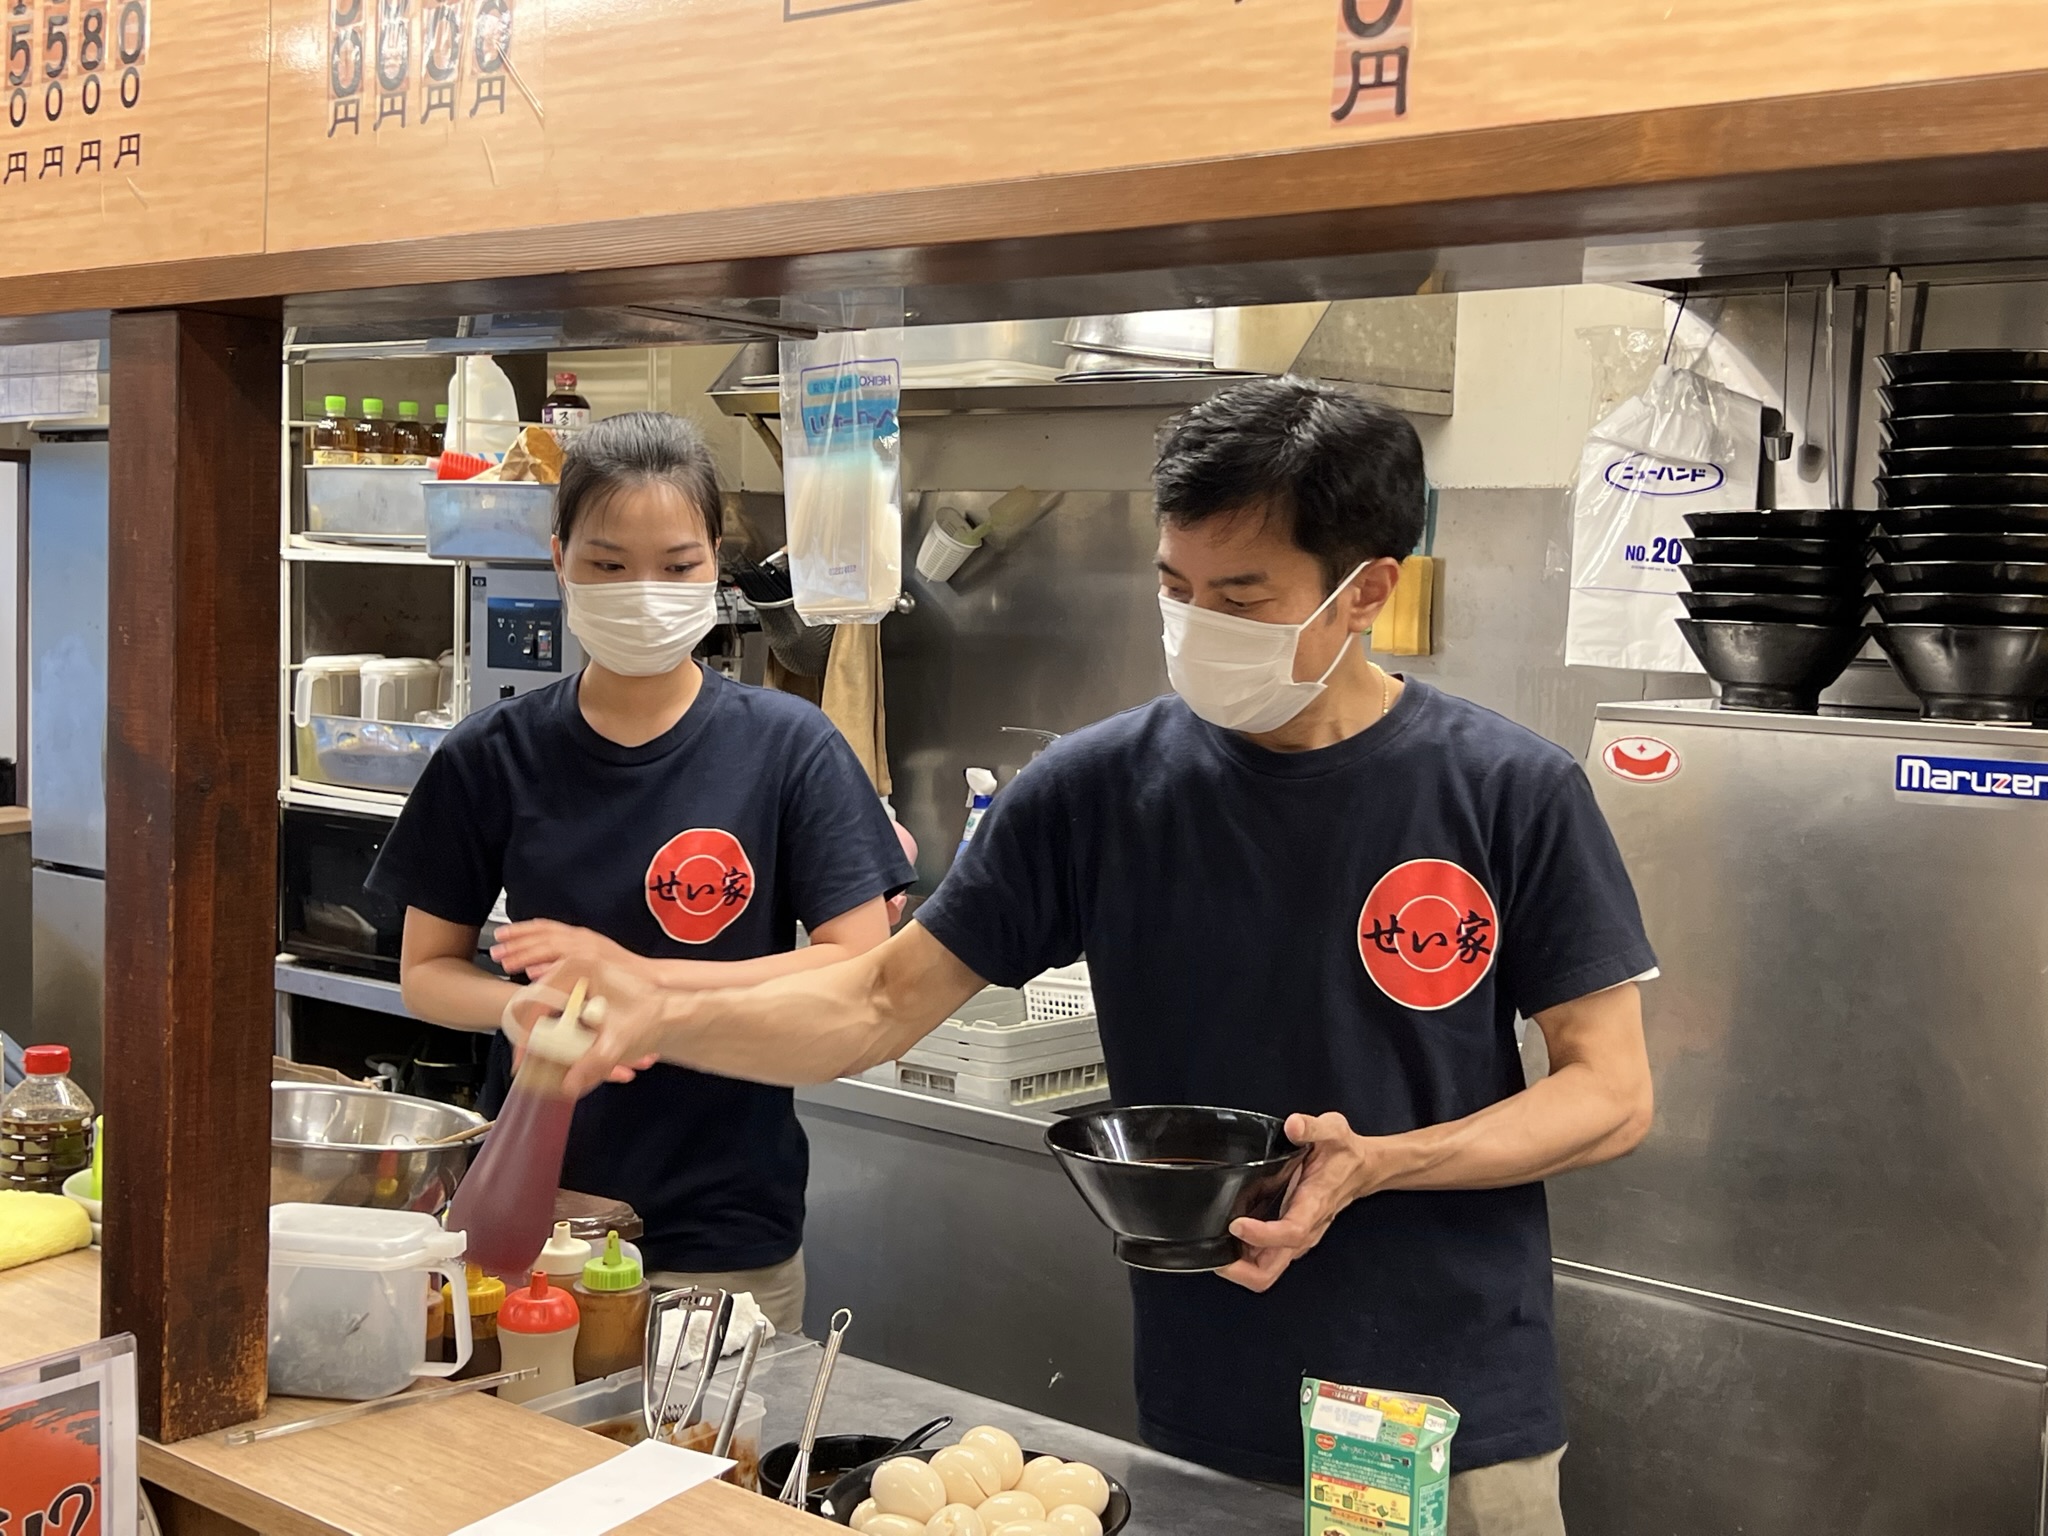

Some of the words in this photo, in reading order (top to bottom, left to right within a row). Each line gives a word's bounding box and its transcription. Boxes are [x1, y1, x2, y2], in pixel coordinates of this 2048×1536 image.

[650, 866, 748, 906] せい家
[1362, 909, 1491, 964] せい家
